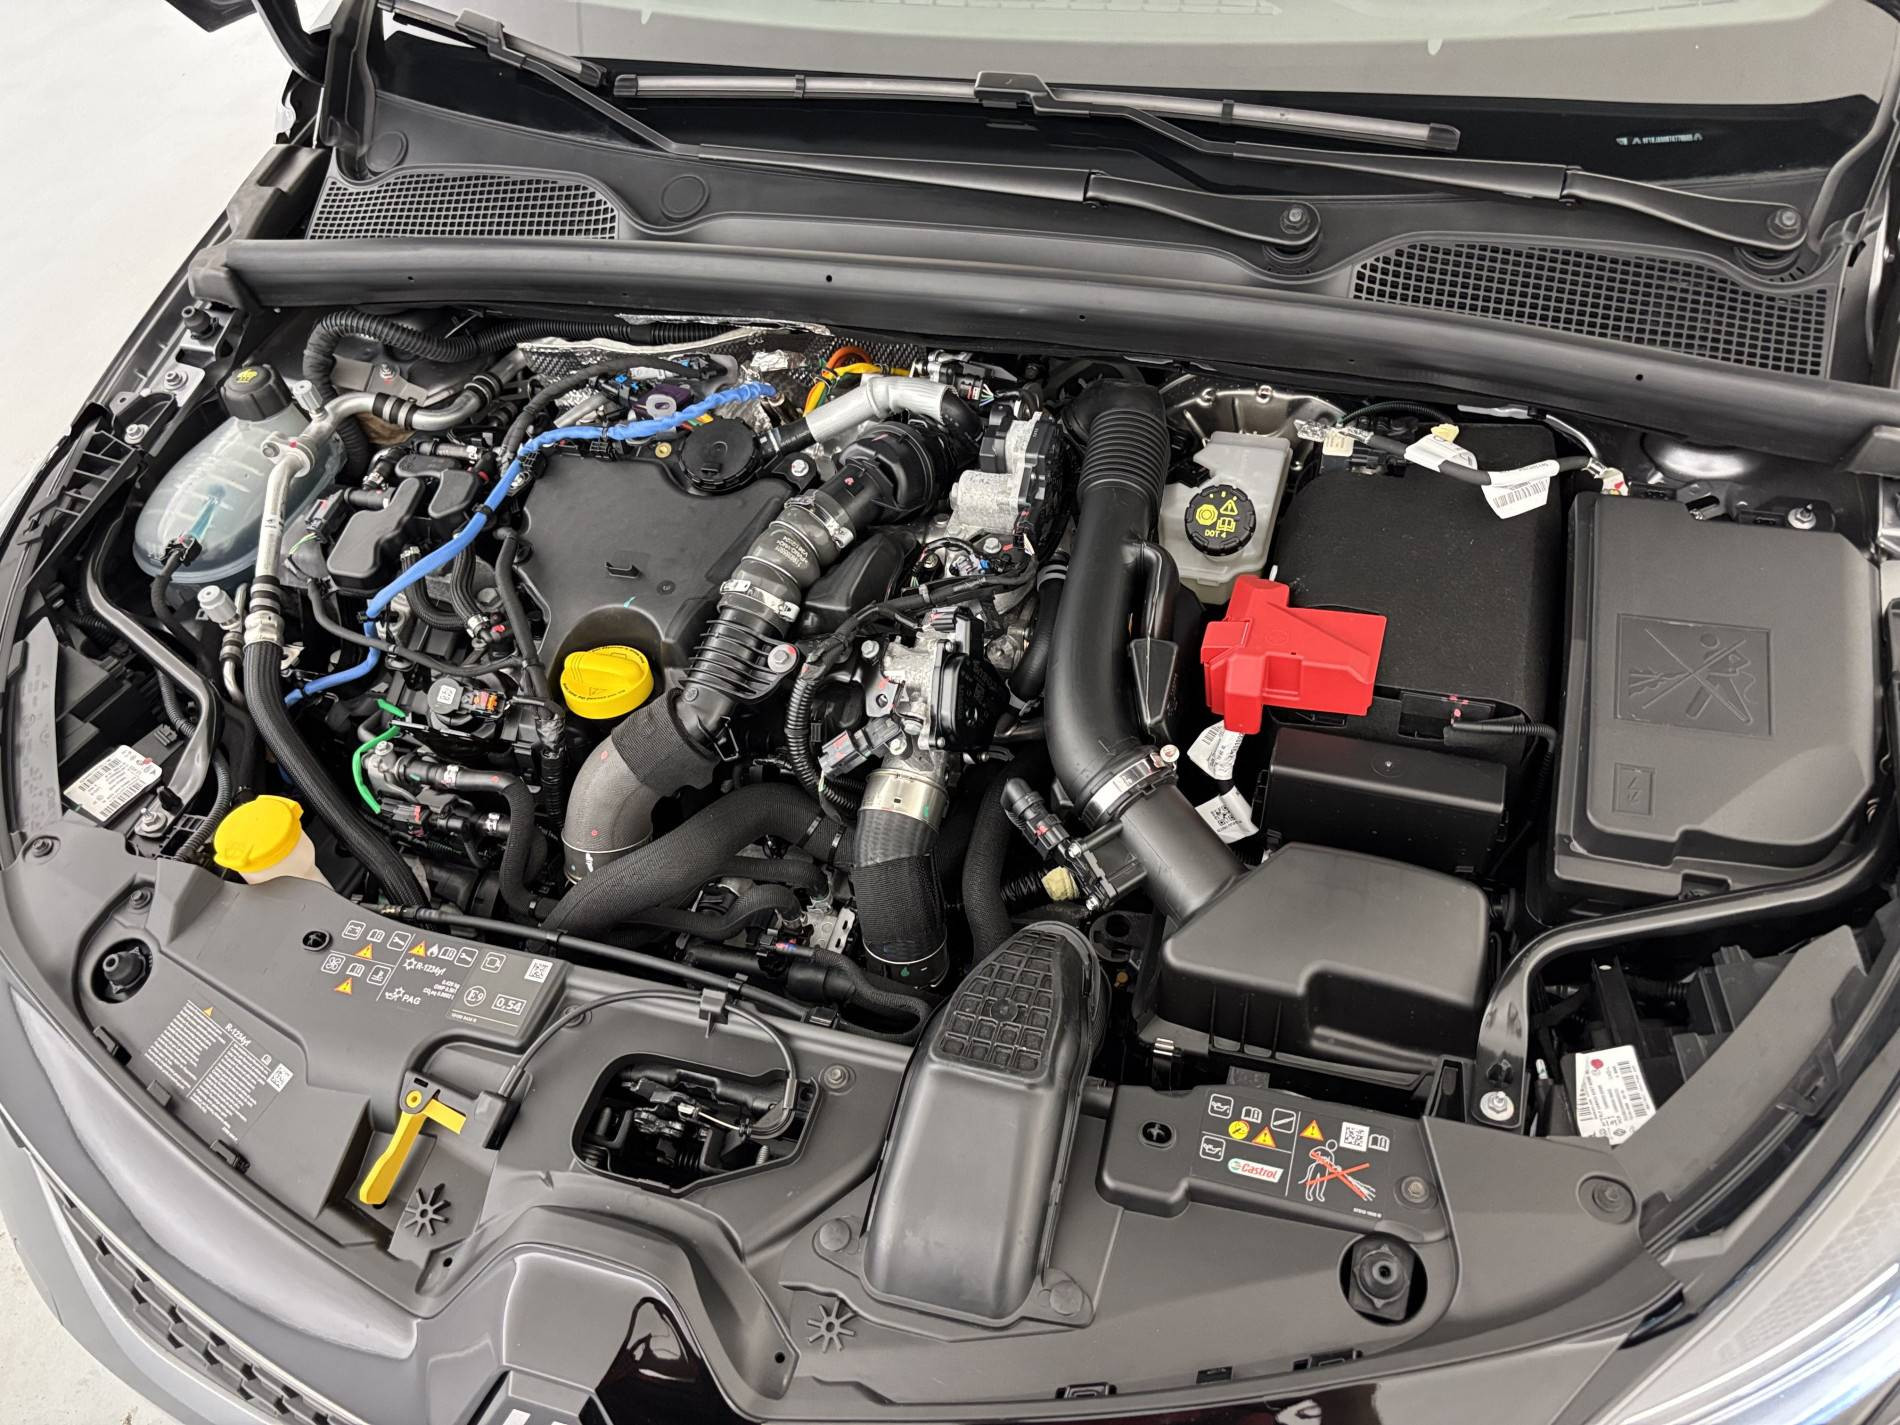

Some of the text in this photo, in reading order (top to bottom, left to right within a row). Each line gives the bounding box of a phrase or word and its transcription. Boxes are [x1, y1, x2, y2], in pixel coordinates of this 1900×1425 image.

[1205, 529, 1220, 537] DOT
[415, 962, 446, 976] R-1234yf
[402, 993, 421, 1005] PAG
[496, 998, 521, 1012] 0,54
[225, 1023, 251, 1047] R-1234yf
[1240, 1163, 1278, 1179] Castrol
